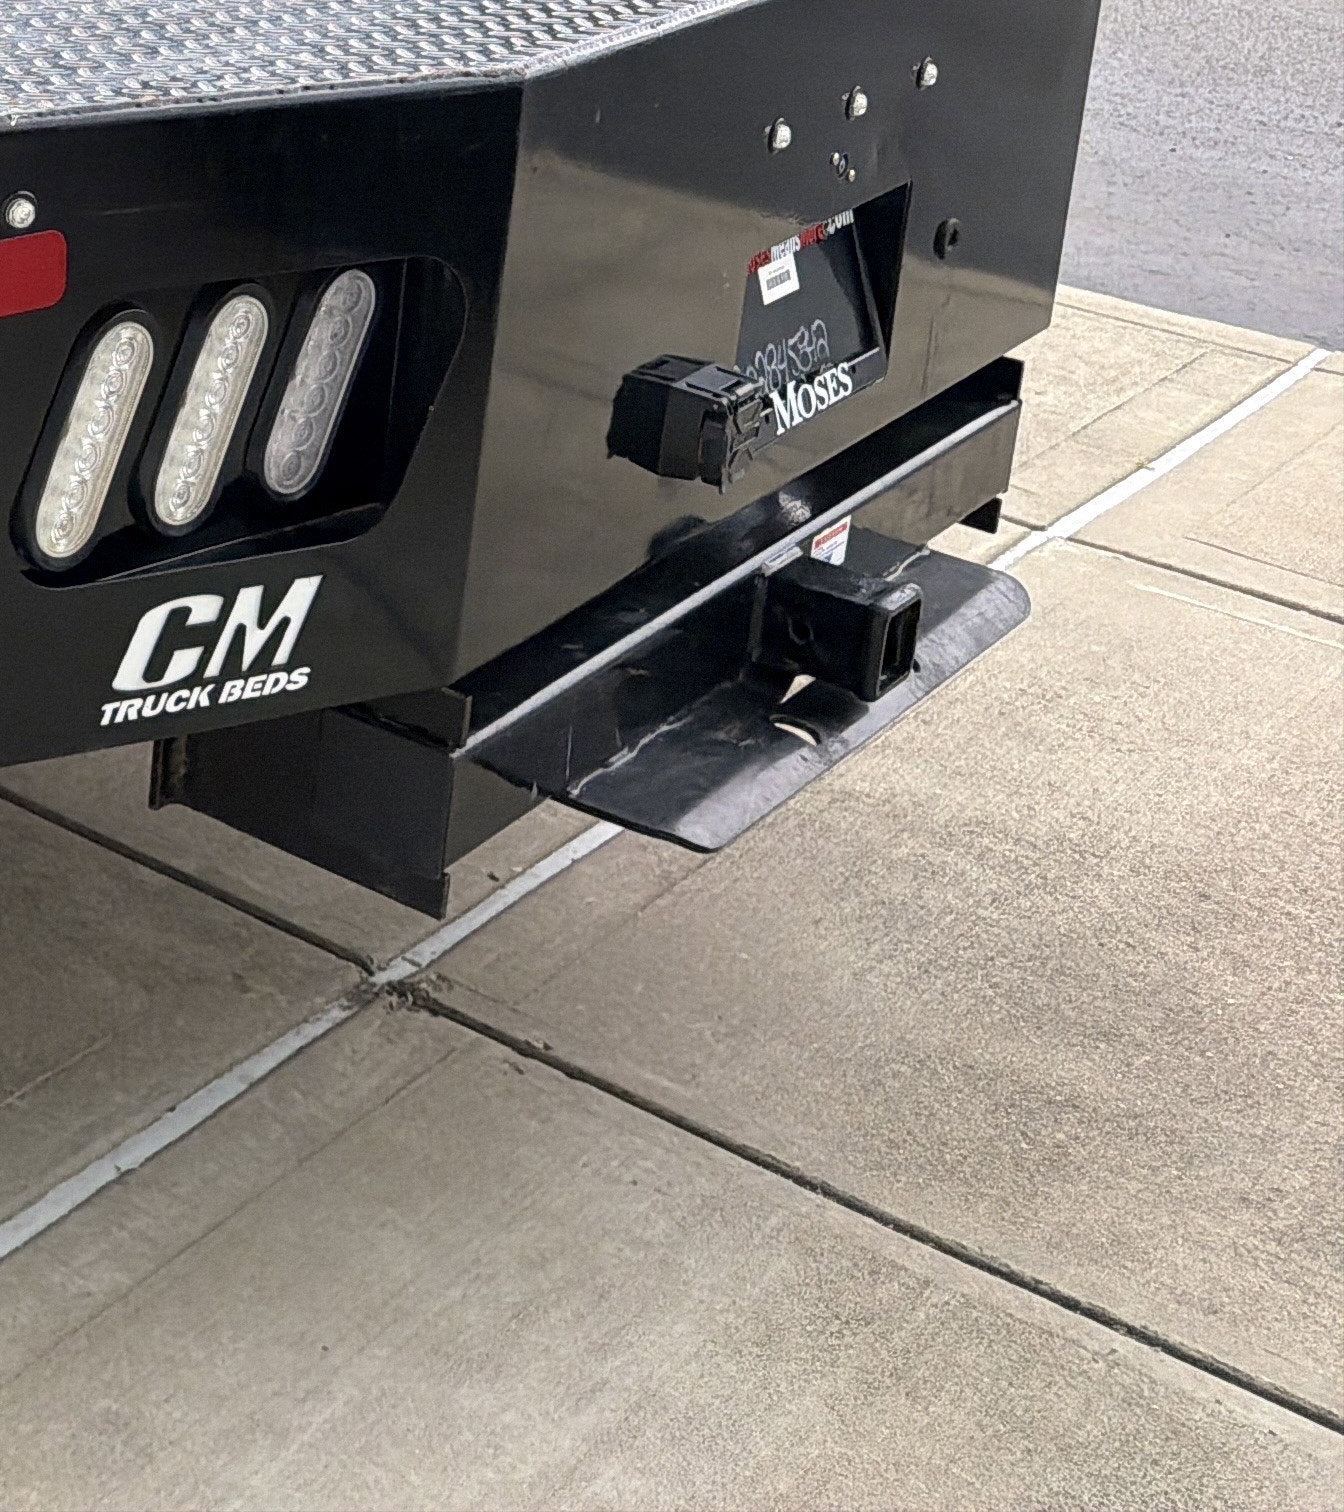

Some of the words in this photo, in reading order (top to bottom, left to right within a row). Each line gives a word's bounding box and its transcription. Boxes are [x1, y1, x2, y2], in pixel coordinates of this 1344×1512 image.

[111, 574, 324, 691] CM
[100, 684, 216, 726] TRUCK
[218, 666, 311, 704] BEDS
